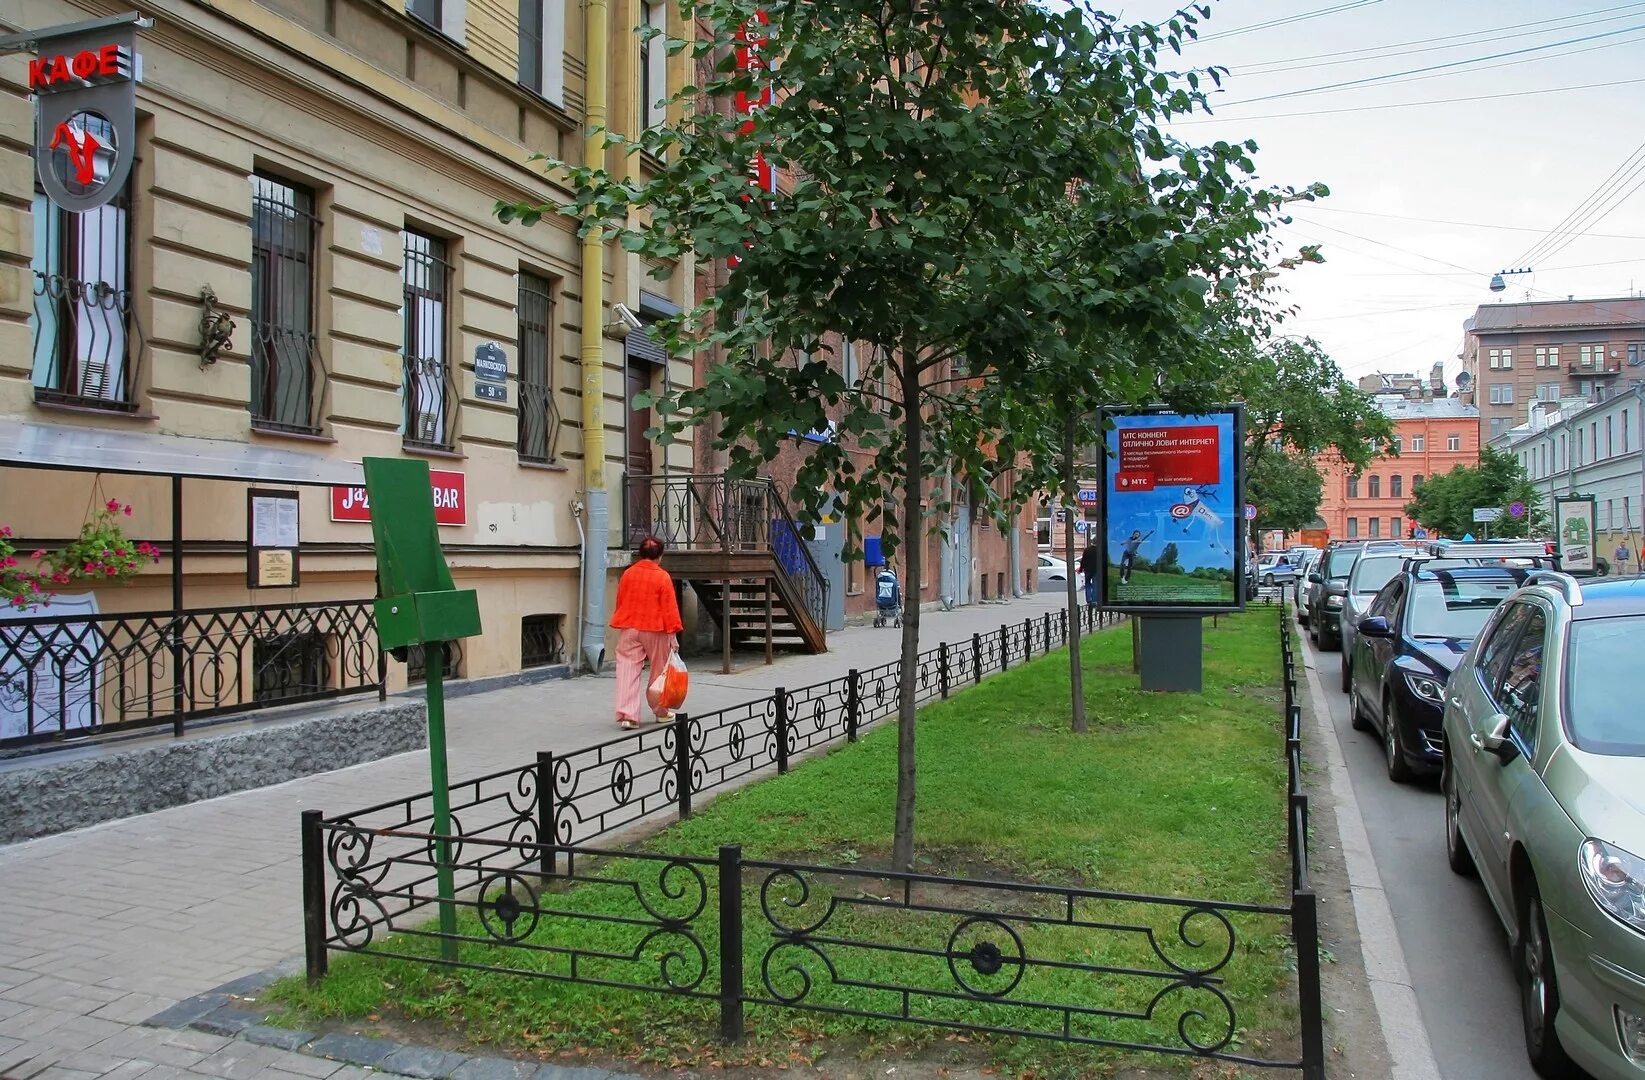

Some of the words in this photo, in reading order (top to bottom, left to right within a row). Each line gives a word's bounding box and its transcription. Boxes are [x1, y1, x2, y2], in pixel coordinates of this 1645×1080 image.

[29, 44, 119, 89] КАФЕ
[488, 386, 495, 397] 50
[1122, 432, 1137, 440] МТС
[1137, 431, 1167, 439] КОННЕКТ
[1122, 440, 1154, 448] ОТЛИЧНО
[1155, 439, 1178, 447] ЛОВИТ
[1179, 438, 1215, 446] ИНТЕРНЕТ!
[433, 487, 459, 509] BAR
